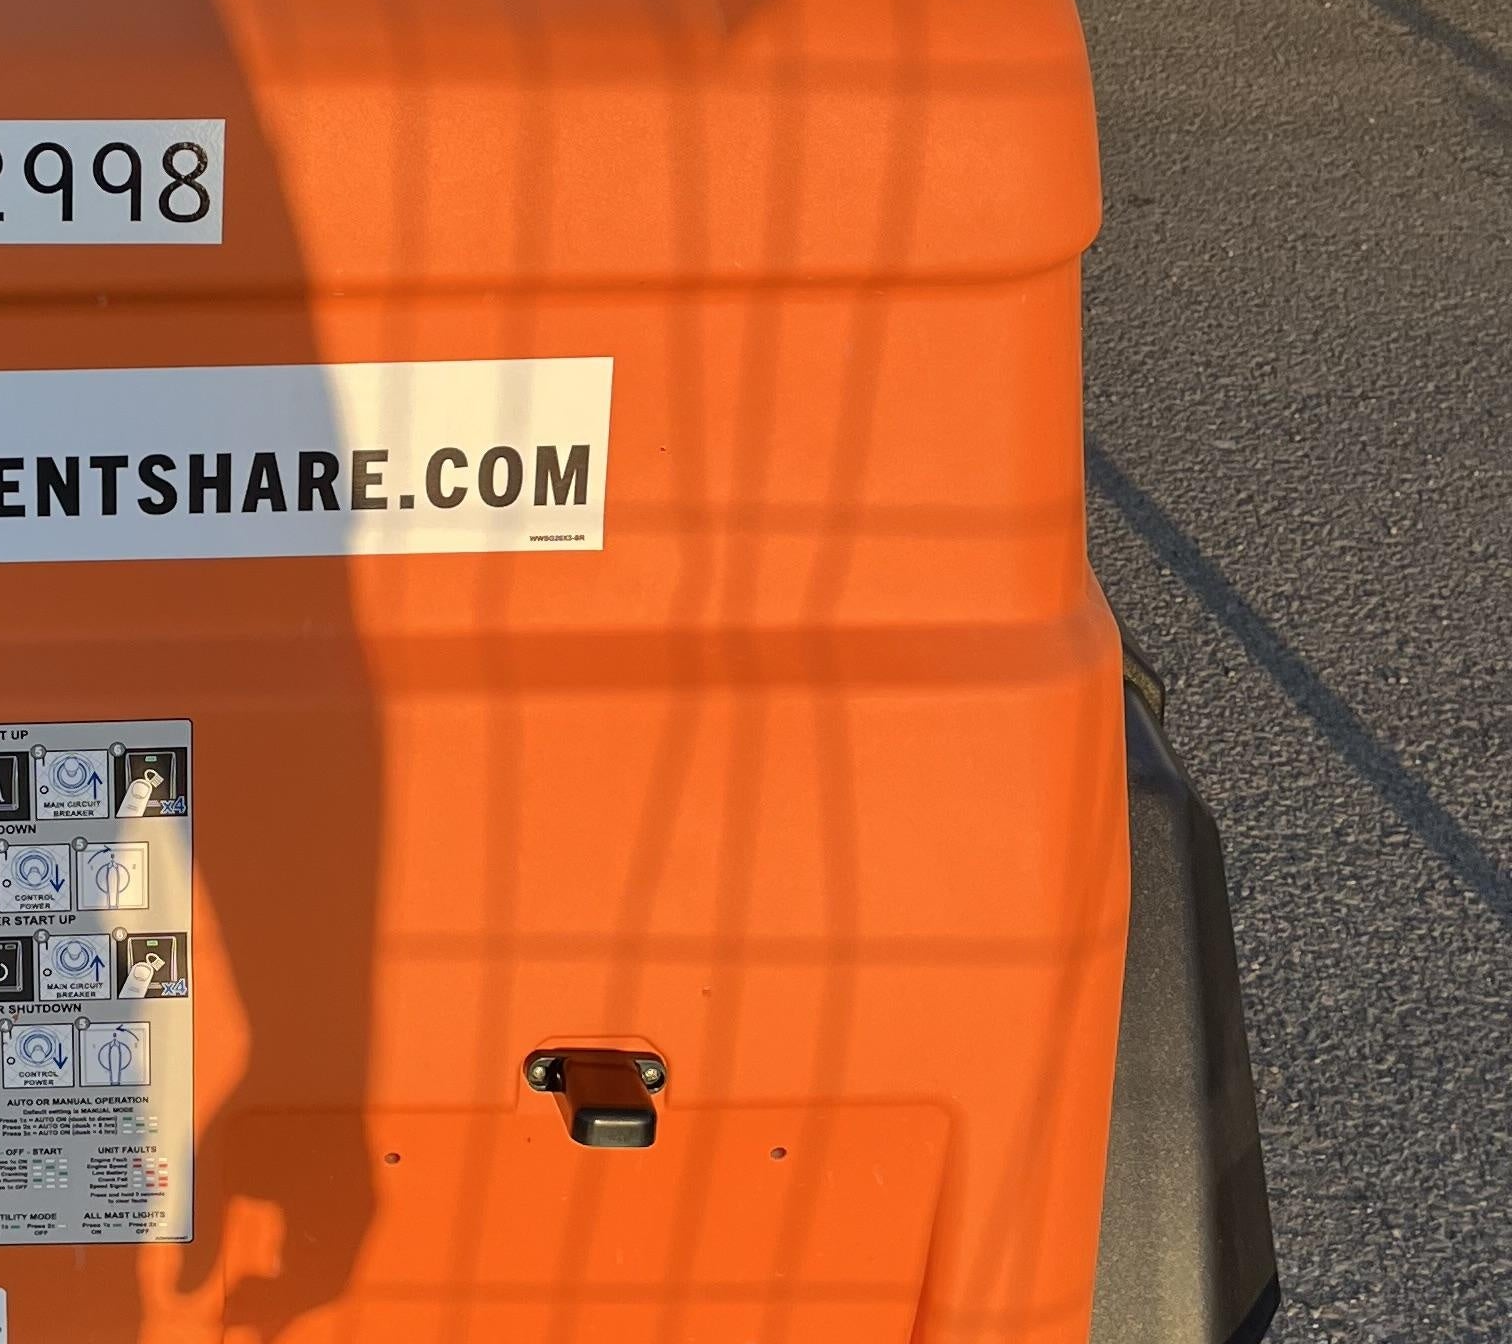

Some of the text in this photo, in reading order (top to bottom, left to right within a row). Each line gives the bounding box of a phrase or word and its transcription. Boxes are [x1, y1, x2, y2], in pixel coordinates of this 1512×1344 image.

[11, 730, 29, 740] UP
[67, 800, 101, 808] CIRCUIT
[160, 796, 186, 815] x4
[14, 894, 55, 902] CONTROL
[14, 915, 55, 927] START
[59, 915, 76, 925] UP
[161, 978, 187, 996] x4
[8, 1003, 82, 1015] SHUTDOWN
[7, 1096, 149, 1107] AUTO OR MANUAL OPERATION
[5, 1148, 25, 1156] OFF
[32, 1147, 63, 1155] START
[98, 1145, 157, 1154] UNIT FAULTS
[30, 1212, 57, 1221] MODE
[104, 1211, 130, 1219] MAST
